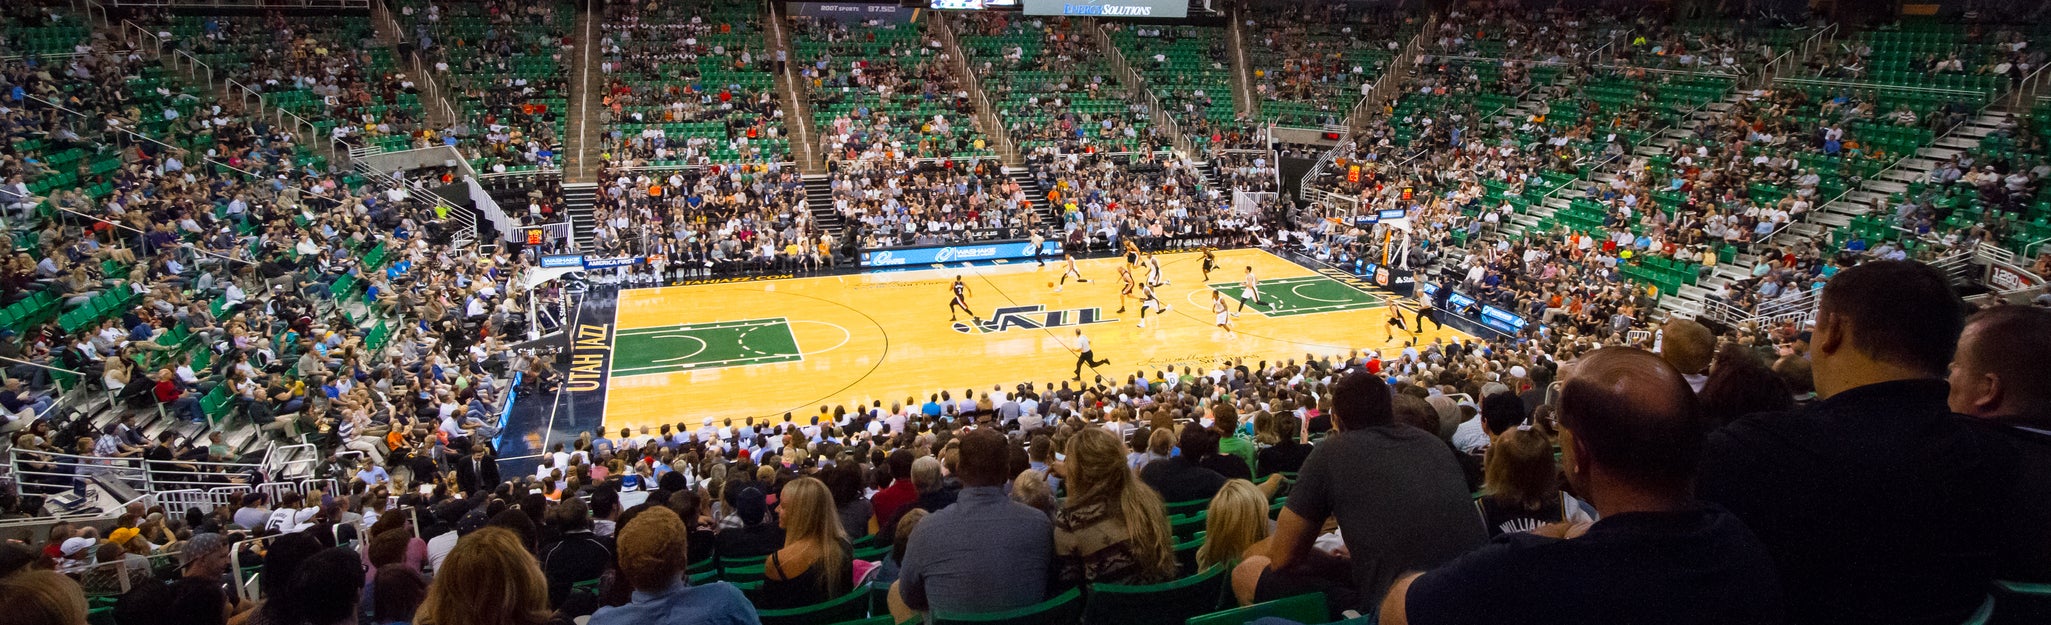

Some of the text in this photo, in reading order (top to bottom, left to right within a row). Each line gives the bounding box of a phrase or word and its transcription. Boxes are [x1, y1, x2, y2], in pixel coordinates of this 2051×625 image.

[972, 230, 998, 238] LEUS
[576, 323, 611, 351] JAZZ
[565, 353, 604, 392] UTAH
